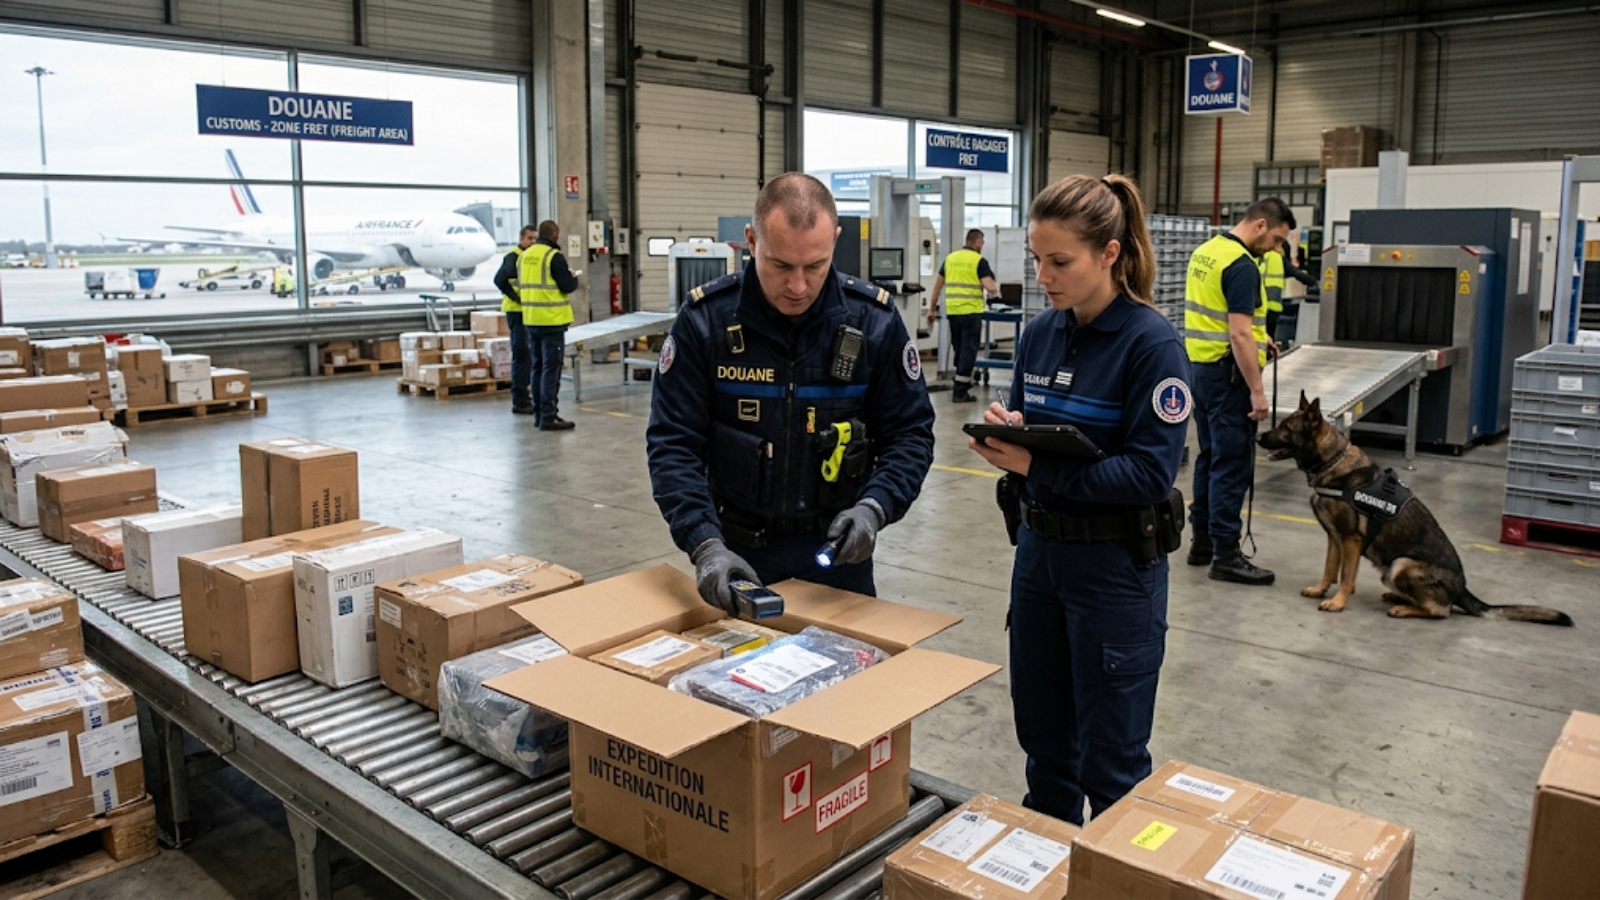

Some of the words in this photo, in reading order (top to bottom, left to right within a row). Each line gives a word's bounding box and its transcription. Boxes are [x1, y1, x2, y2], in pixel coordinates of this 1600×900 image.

[268, 96, 353, 120] DOUANE
[1190, 93, 1235, 106] DOUANE
[206, 116, 262, 132] CUSTOMS
[303, 122, 328, 135] FRET
[330, 125, 376, 138] (FREIGHT
[378, 127, 408, 140] AREA)
[717, 365, 775, 383] DOUANE
[607, 738, 704, 795] EXPEDITION
[588, 755, 730, 833] INTERNATIONALE
[819, 780, 866, 823] FRAGILE
